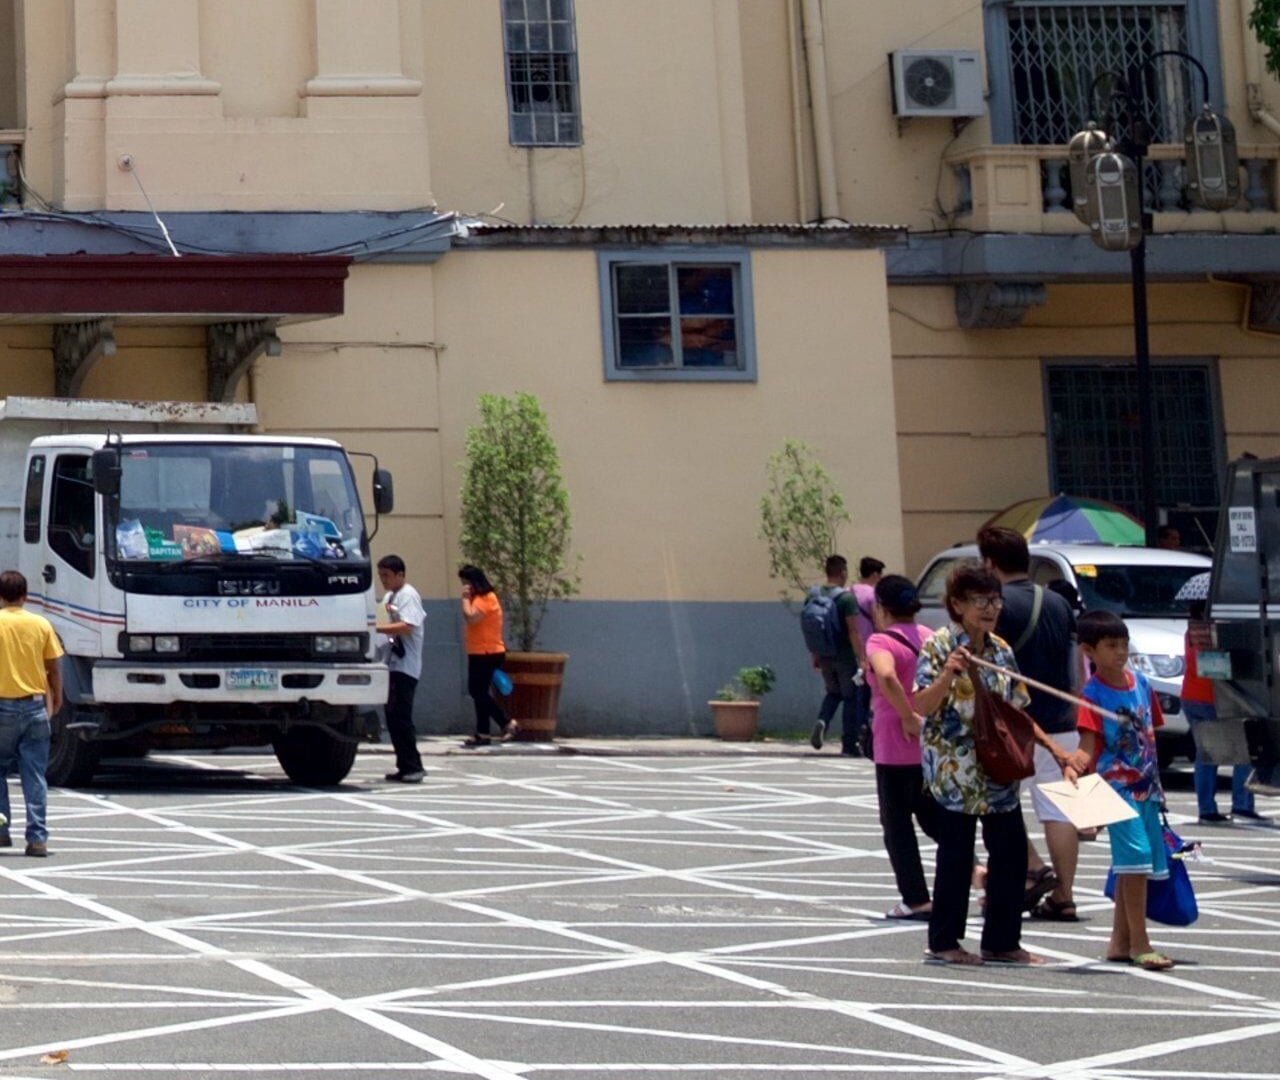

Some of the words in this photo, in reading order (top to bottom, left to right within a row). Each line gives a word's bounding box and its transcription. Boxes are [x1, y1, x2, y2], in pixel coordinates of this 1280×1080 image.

[217, 580, 281, 595] ISUZU
[183, 599, 222, 608] CITY
[227, 599, 249, 608] OF
[255, 598, 320, 608] MANILA
